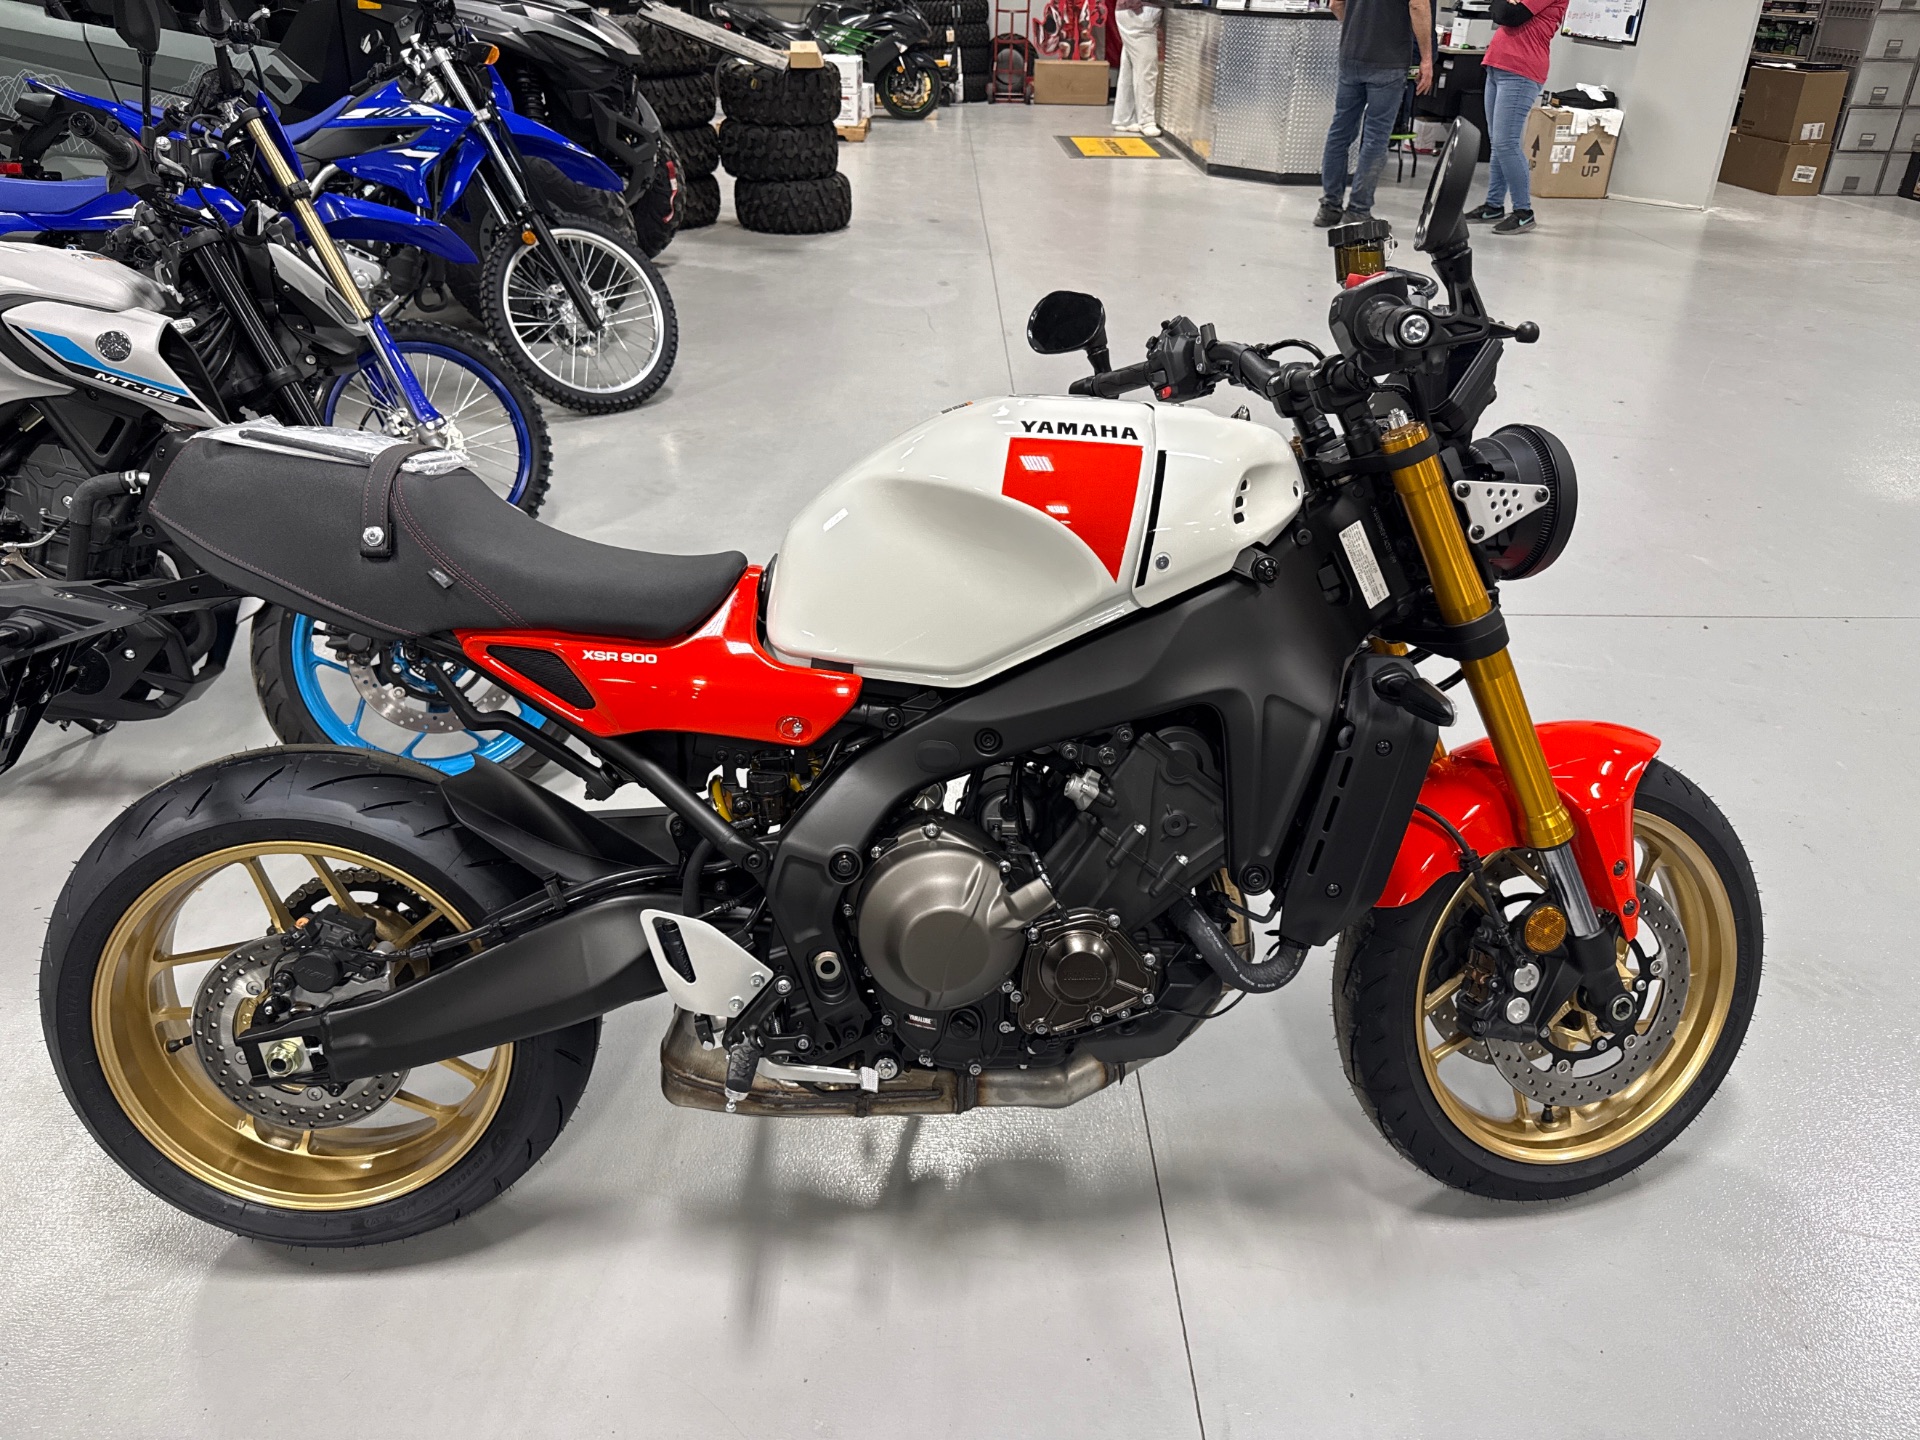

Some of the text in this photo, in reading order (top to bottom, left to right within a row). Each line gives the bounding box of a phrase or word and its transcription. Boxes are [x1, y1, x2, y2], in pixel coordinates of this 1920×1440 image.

[1581, 165, 1600, 178] UP
[94, 372, 181, 403] MT-03
[1020, 420, 1139, 440] YAMAHA
[582, 649, 658, 664] XSR 900
